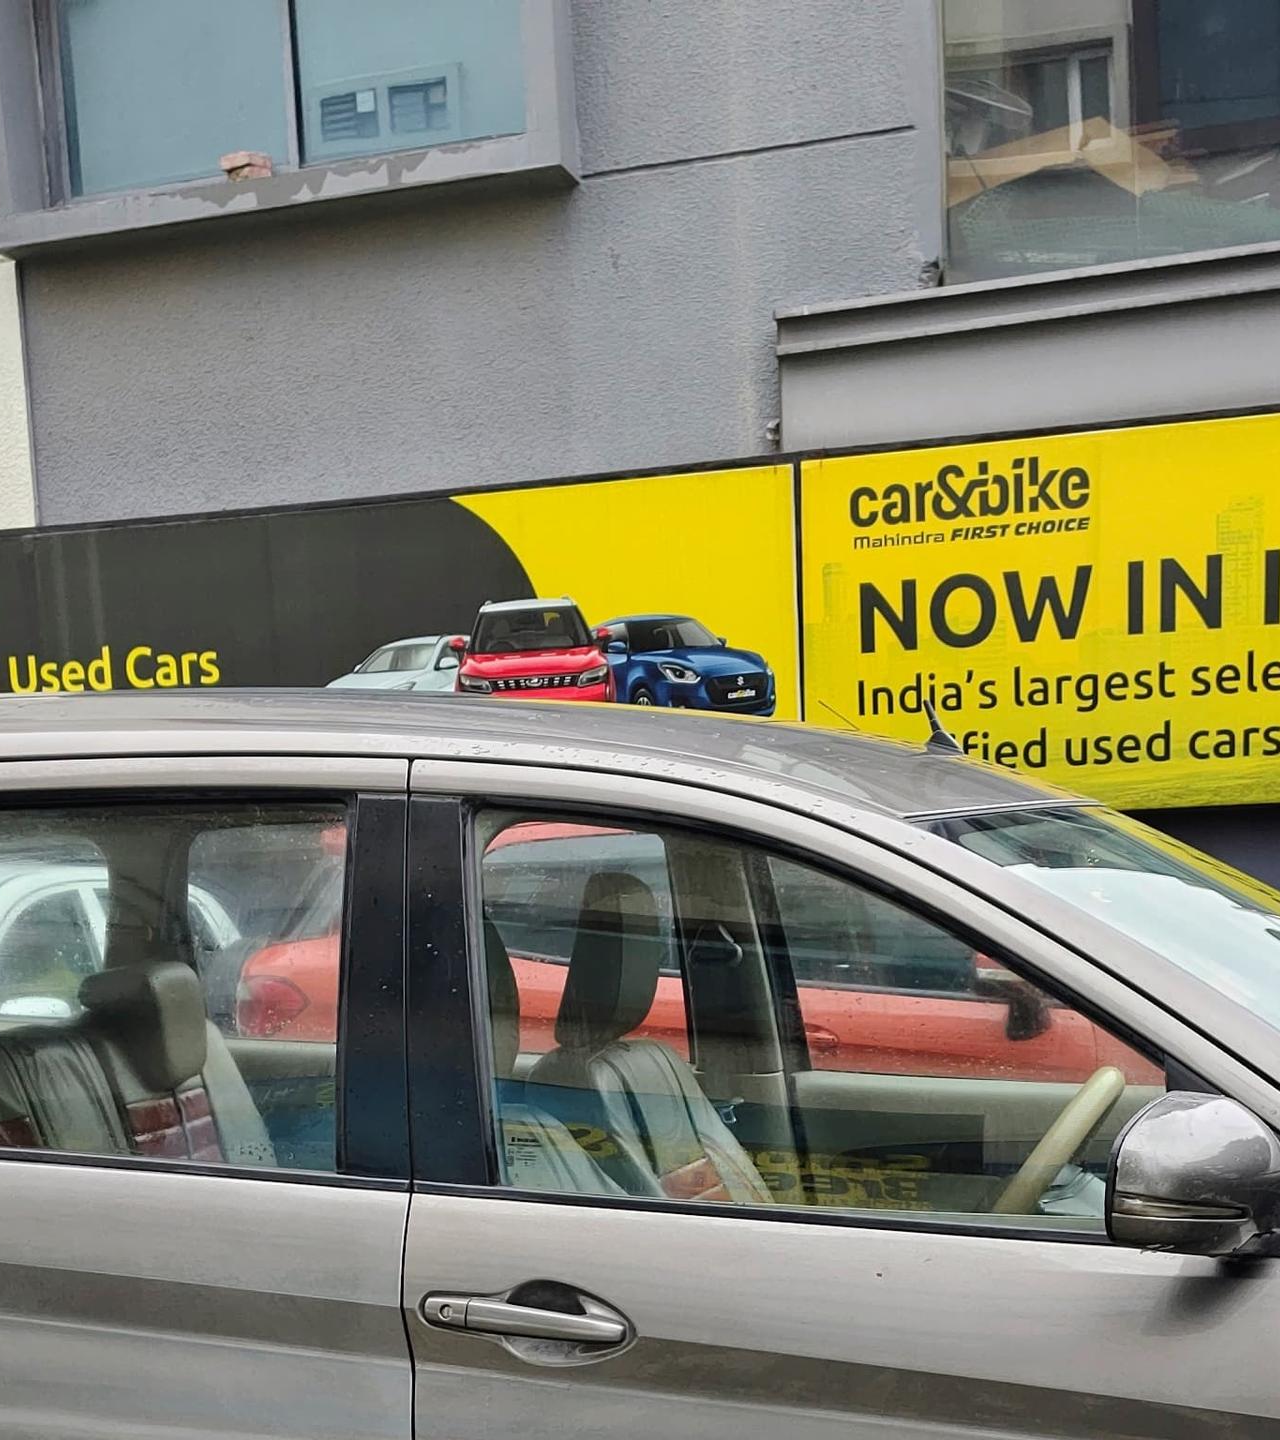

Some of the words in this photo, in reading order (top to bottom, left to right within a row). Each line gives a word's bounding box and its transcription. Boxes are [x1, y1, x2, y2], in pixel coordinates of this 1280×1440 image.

[850, 456, 1090, 528] car&bike
[853, 531, 945, 550] Mahindra
[950, 525, 1010, 542] FIRST
[1014, 517, 1090, 536] CHOICE
[859, 565, 1093, 654] NOW
[1127, 554, 1222, 635] IN
[9, 645, 113, 693] Used
[125, 646, 220, 689] Cars
[858, 669, 998, 716] India's
[1013, 661, 1176, 712] largest
[1065, 720, 1172, 767] used
